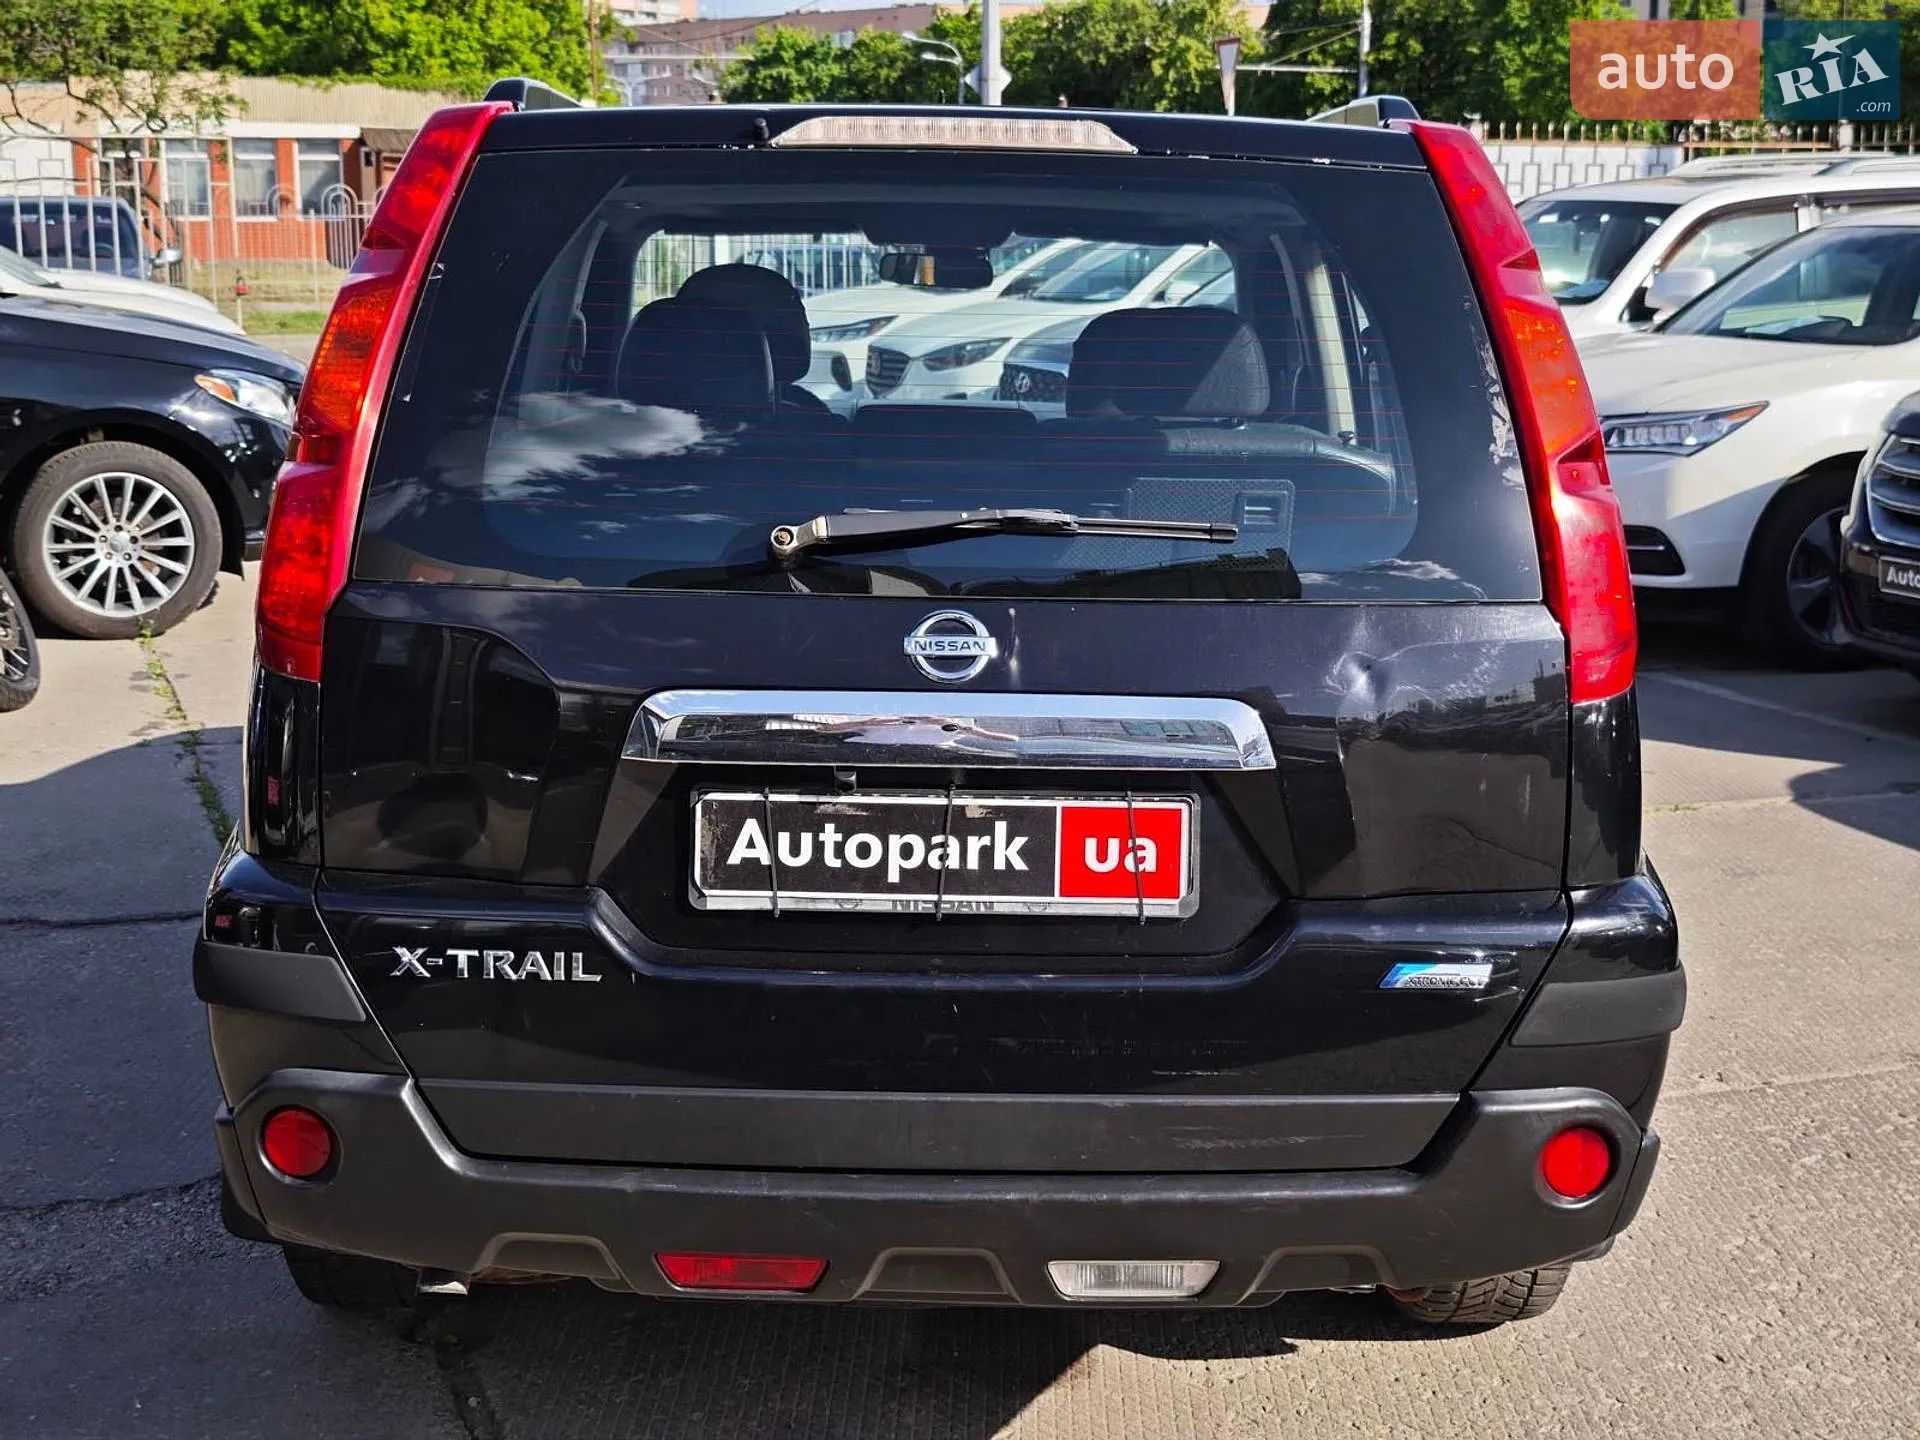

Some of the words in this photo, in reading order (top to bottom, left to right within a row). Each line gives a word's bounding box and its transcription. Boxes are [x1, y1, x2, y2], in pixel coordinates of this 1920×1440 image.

[914, 640, 986, 652] NISSAN
[726, 818, 1029, 883] Autopark
[1083, 836, 1158, 873] ua
[389, 946, 603, 982] X-TRAIL
